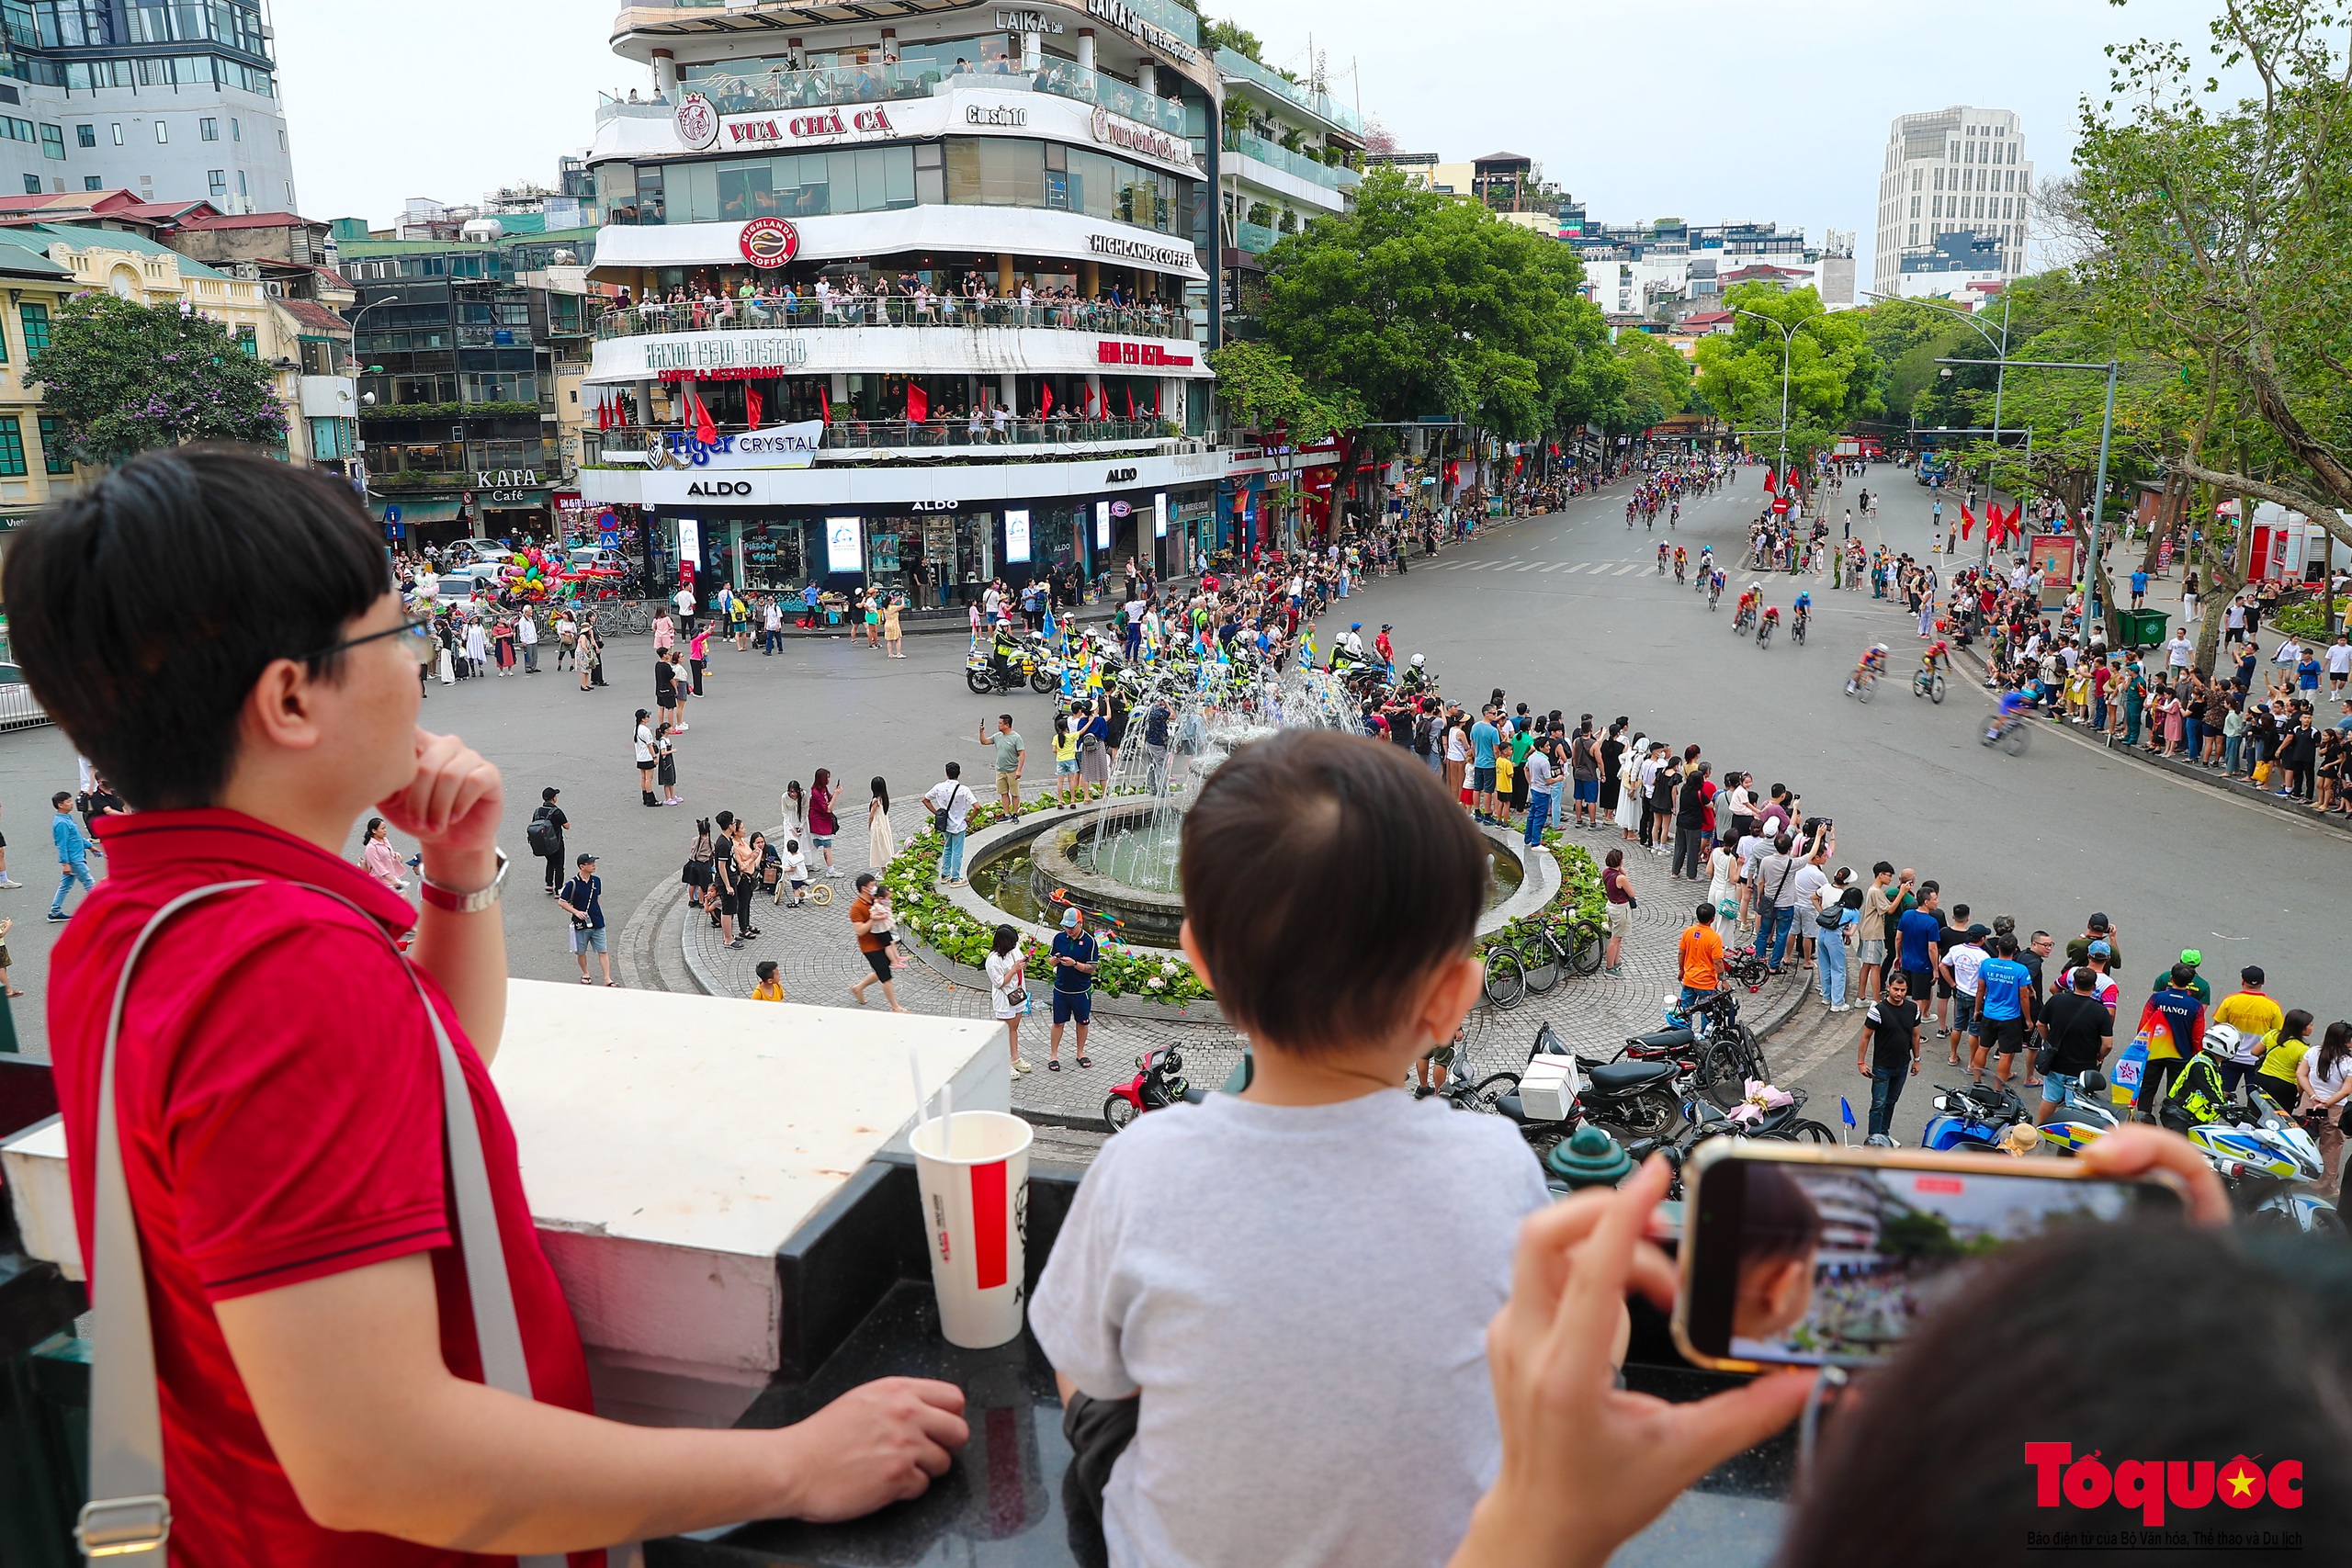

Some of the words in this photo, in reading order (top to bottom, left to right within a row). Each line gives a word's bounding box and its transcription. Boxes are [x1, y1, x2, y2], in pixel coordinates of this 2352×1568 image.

[995, 9, 1048, 32] LAIKA
[1087, 0, 1126, 28] LAIKA
[1143, 24, 1159, 45] The
[1159, 33, 1197, 65] Exceptional
[729, 118, 783, 142] VUA
[789, 106, 847, 137] CHẢ
[854, 104, 892, 132] CÁ
[1109, 123, 1133, 149] VUA
[742, 220, 794, 243] HIGHLANDS
[750, 253, 789, 266] COFFEE
[1091, 234, 1158, 261] HIGHLANDS
[1159, 249, 1193, 268] COFFEE
[644, 342, 689, 367] HANOI
[695, 340, 734, 366] 1930
[741, 338, 807, 364] BISTRO
[658, 369, 696, 382] COFFEE
[699, 369, 708, 381] &
[711, 366, 785, 380] RESTAURANT
[667, 431, 736, 466] Tiger
[741, 436, 820, 452] CRYSTAL
[476, 469, 538, 488] KAFA
[1105, 468, 1136, 483] ALDO
[492, 491, 524, 502] Café
[687, 482, 752, 495] ALDO
[912, 501, 958, 511] ALDO
[1053, 543, 1070, 552] ALDO
[2159, 1004, 2188, 1016] HANOI
